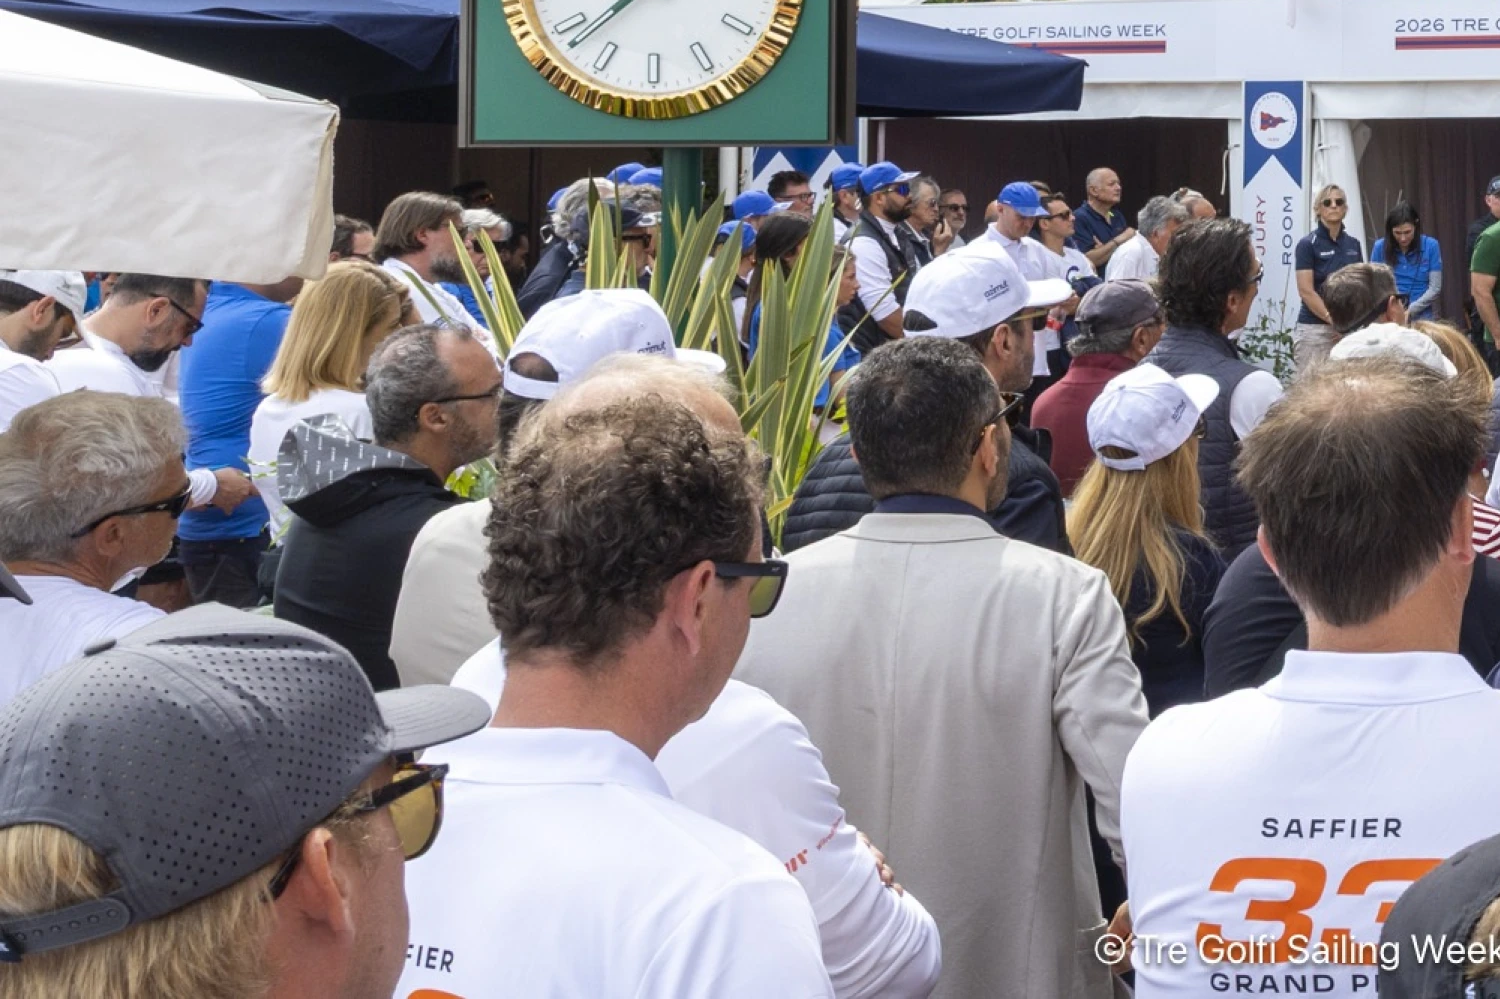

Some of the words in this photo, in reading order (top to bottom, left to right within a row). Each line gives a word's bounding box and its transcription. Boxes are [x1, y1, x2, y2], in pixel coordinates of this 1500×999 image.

[993, 26, 1042, 40] GOLFI
[1046, 25, 1112, 39] SAILING
[1117, 23, 1166, 37] WEEK
[1395, 18, 1445, 33] 2026
[1451, 18, 1490, 32] TRE
[1255, 196, 1266, 256] JURY
[1282, 196, 1293, 265] ROOM
[1261, 817, 1402, 840] SAFFIER
[1210, 972, 1335, 994] GRAND
[1352, 973, 1381, 994] P
